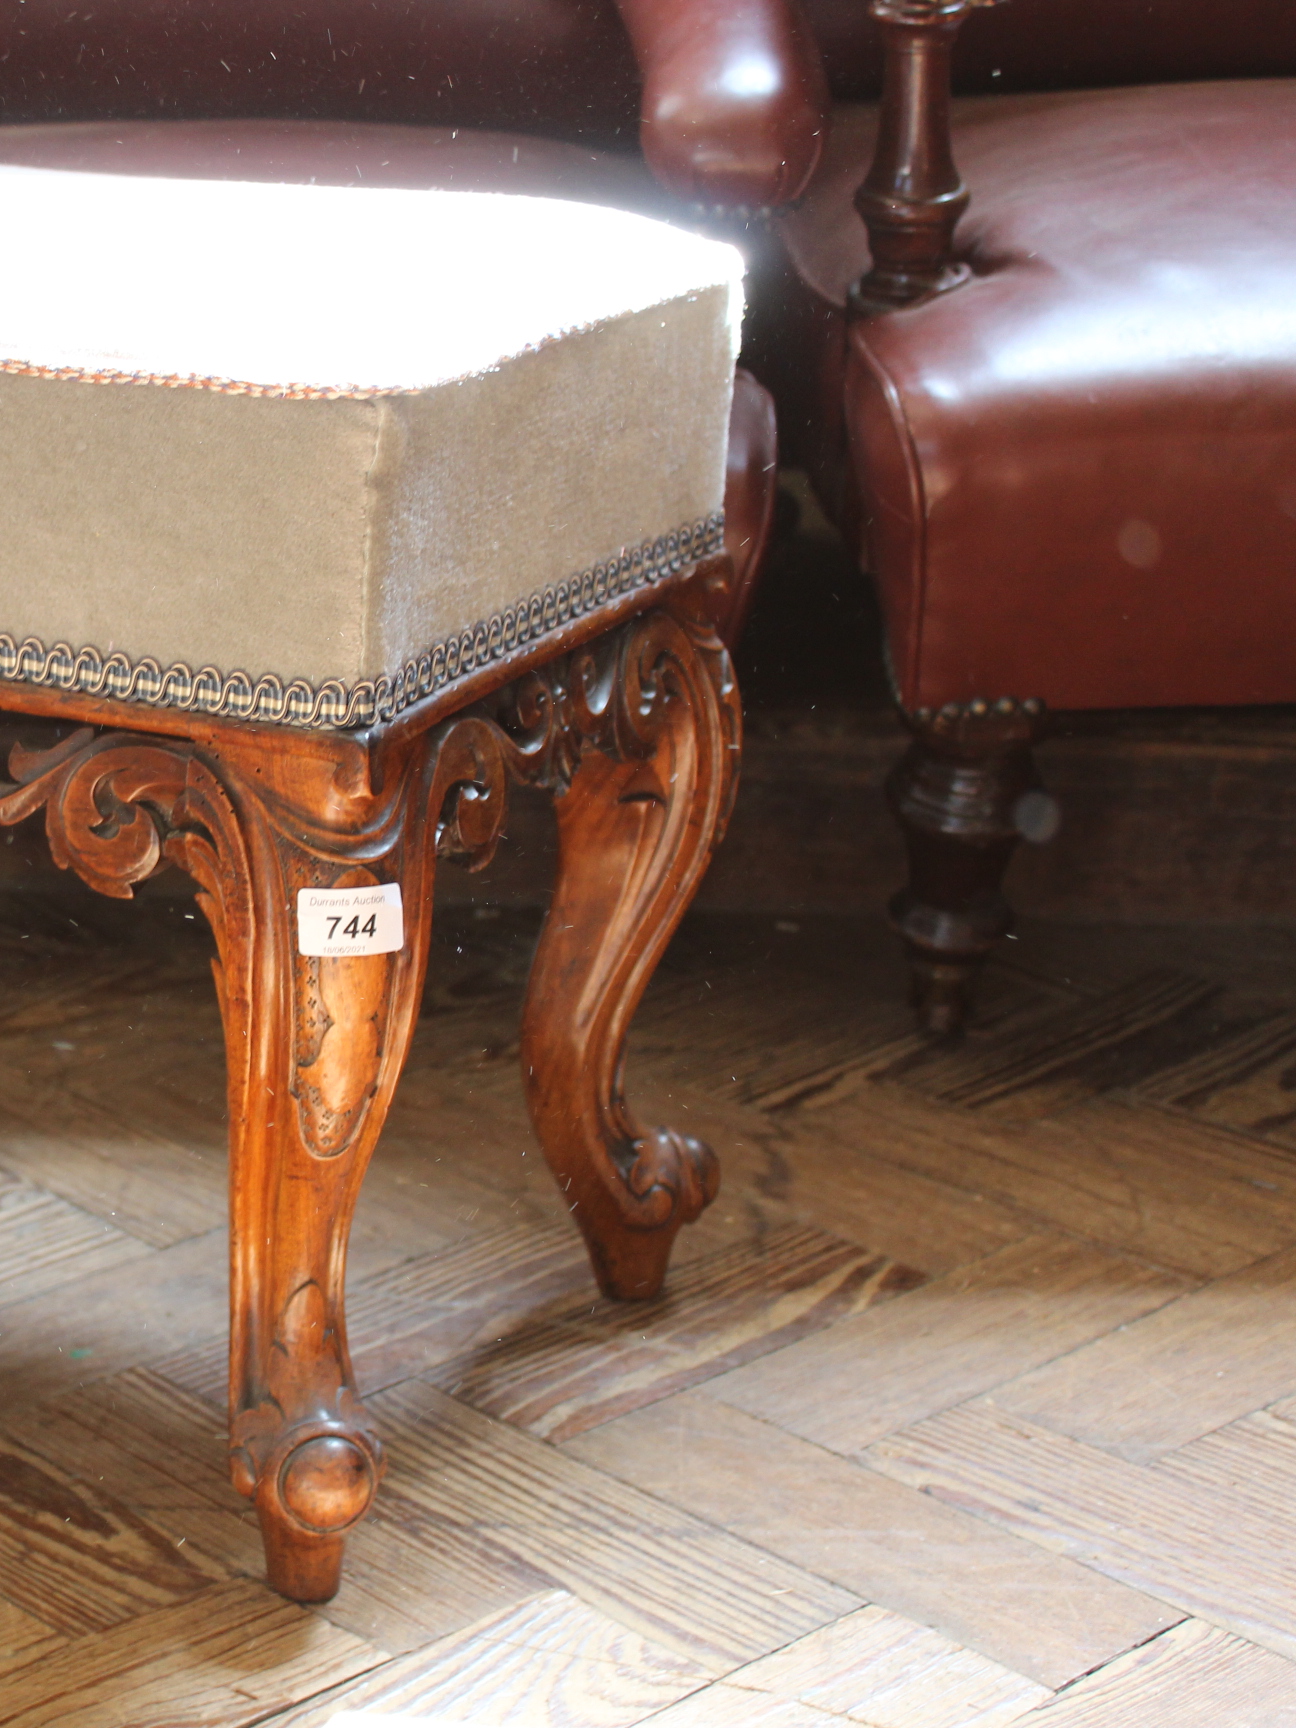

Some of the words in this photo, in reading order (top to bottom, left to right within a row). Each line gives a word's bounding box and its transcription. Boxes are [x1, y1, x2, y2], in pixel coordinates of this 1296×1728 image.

[309, 896, 350, 907] Durrants
[352, 894, 386, 906] Auction
[326, 912, 377, 940] 744
